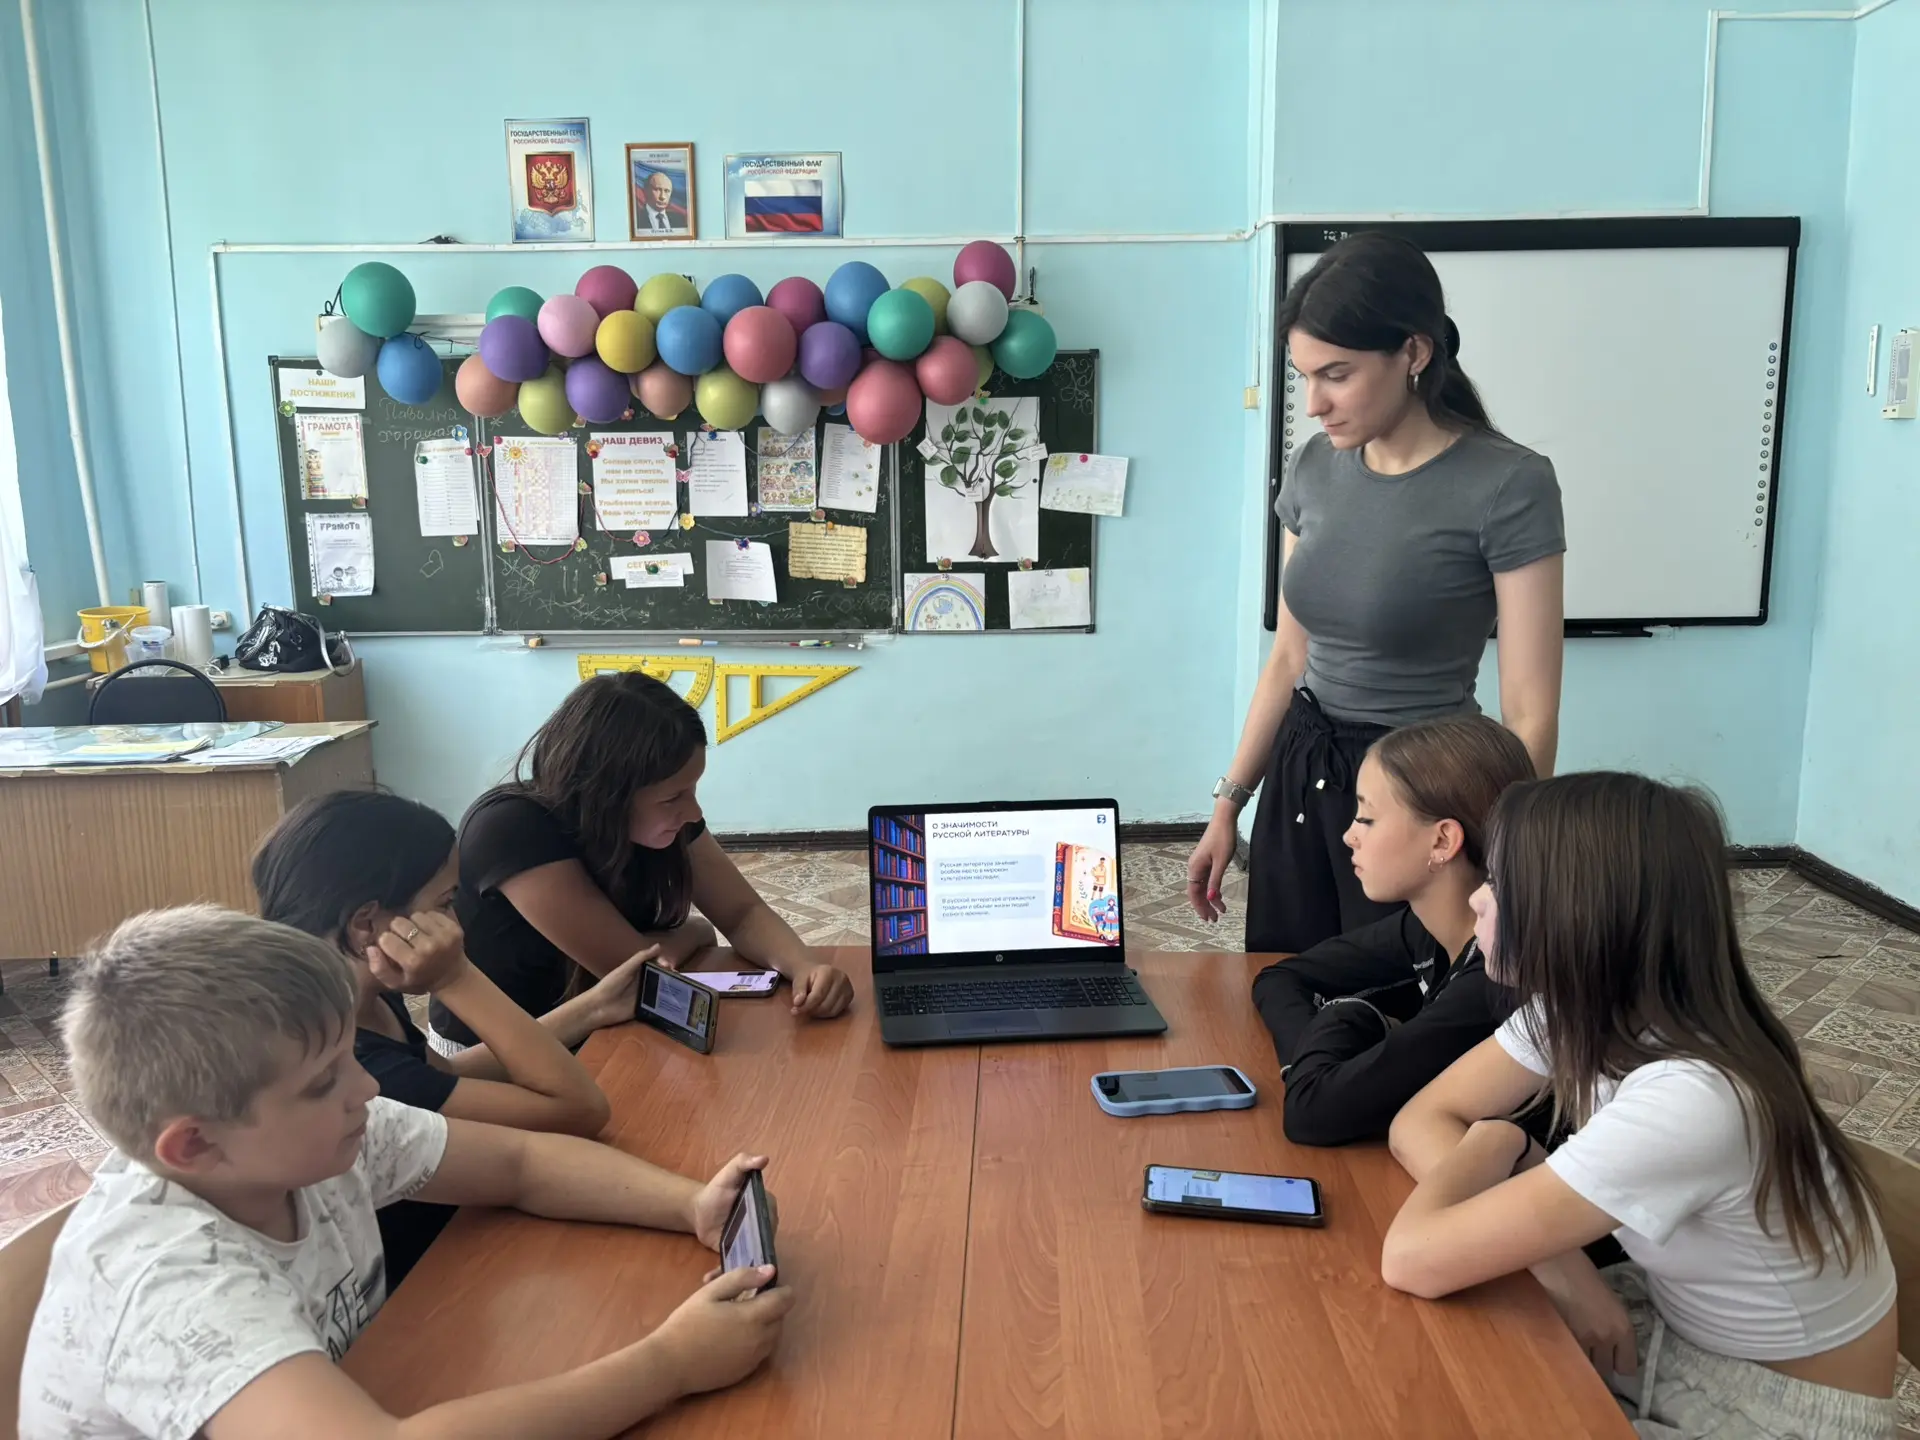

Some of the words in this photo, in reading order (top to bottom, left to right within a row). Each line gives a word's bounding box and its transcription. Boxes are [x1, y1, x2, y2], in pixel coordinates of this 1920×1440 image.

[510, 129, 568, 137] ГОСУДАРСТВЕННЫЙ
[742, 159, 805, 168] ГОСУДАРСТВЕННЫЙ
[747, 168, 784, 176] РОССИЙСКОЙ
[308, 378, 336, 386] НАШИ
[290, 389, 356, 399] ДОСТИЖЕНИЯ
[307, 423, 353, 431] ГРАМОТА
[602, 437, 626, 445] НАШ
[629, 437, 664, 446] ДЕВИЗ
[940, 821, 999, 830] ЗНАЧИМОСТИ
[932, 830, 972, 839] РУССКОЙ
[974, 829, 1030, 838] ЛИТЕРАТУРЫ
